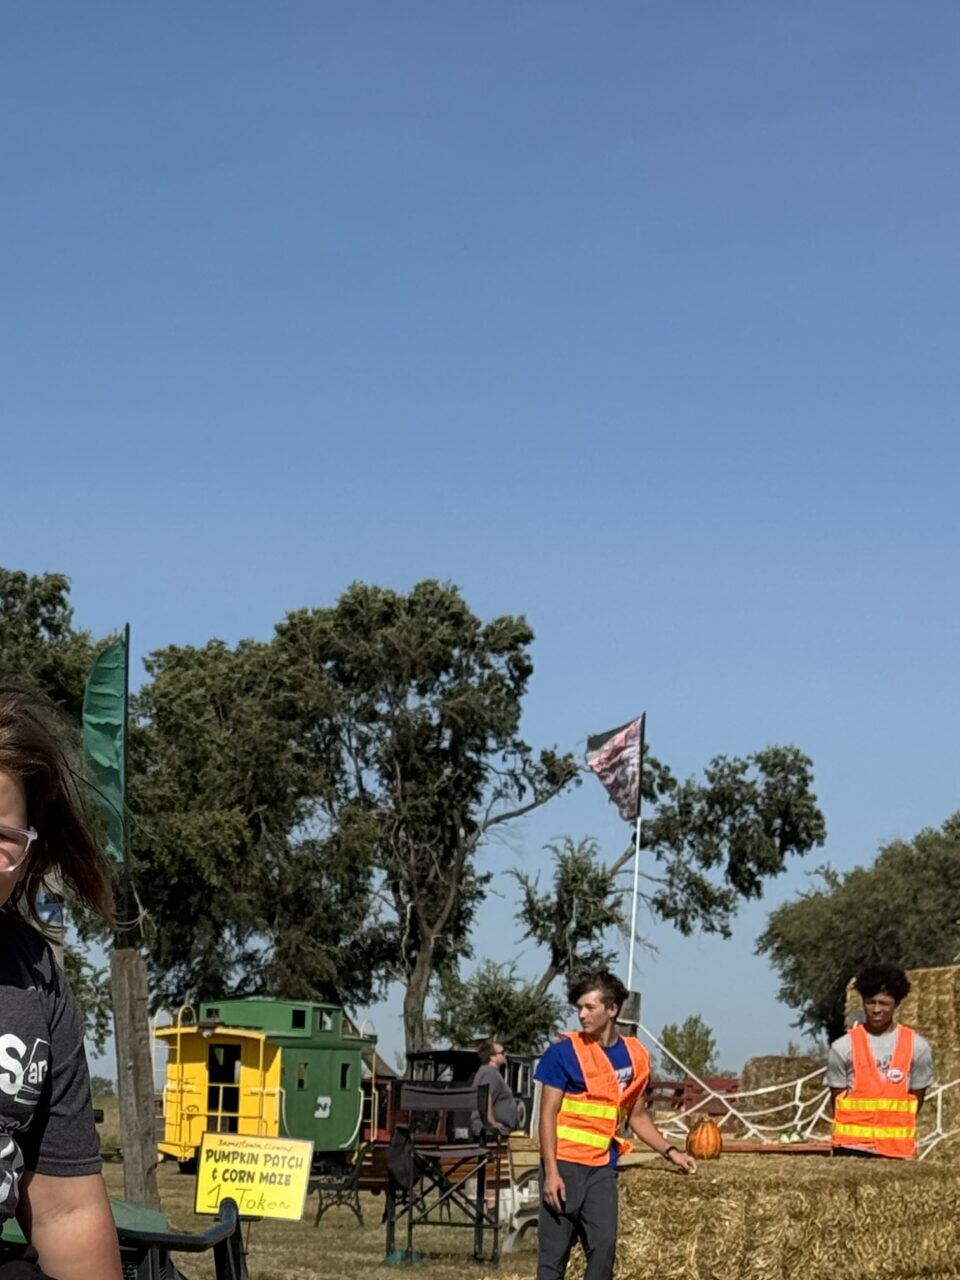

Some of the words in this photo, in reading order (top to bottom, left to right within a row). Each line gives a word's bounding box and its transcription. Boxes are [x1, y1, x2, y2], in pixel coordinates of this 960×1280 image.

[205, 1148, 259, 1166] PUMPKIN
[263, 1153, 304, 1169] PATCH
[221, 1168, 256, 1184] CORN
[258, 1172, 293, 1187] MAZE
[207, 1184, 222, 1209] 1
[234, 1187, 291, 1211] Token
